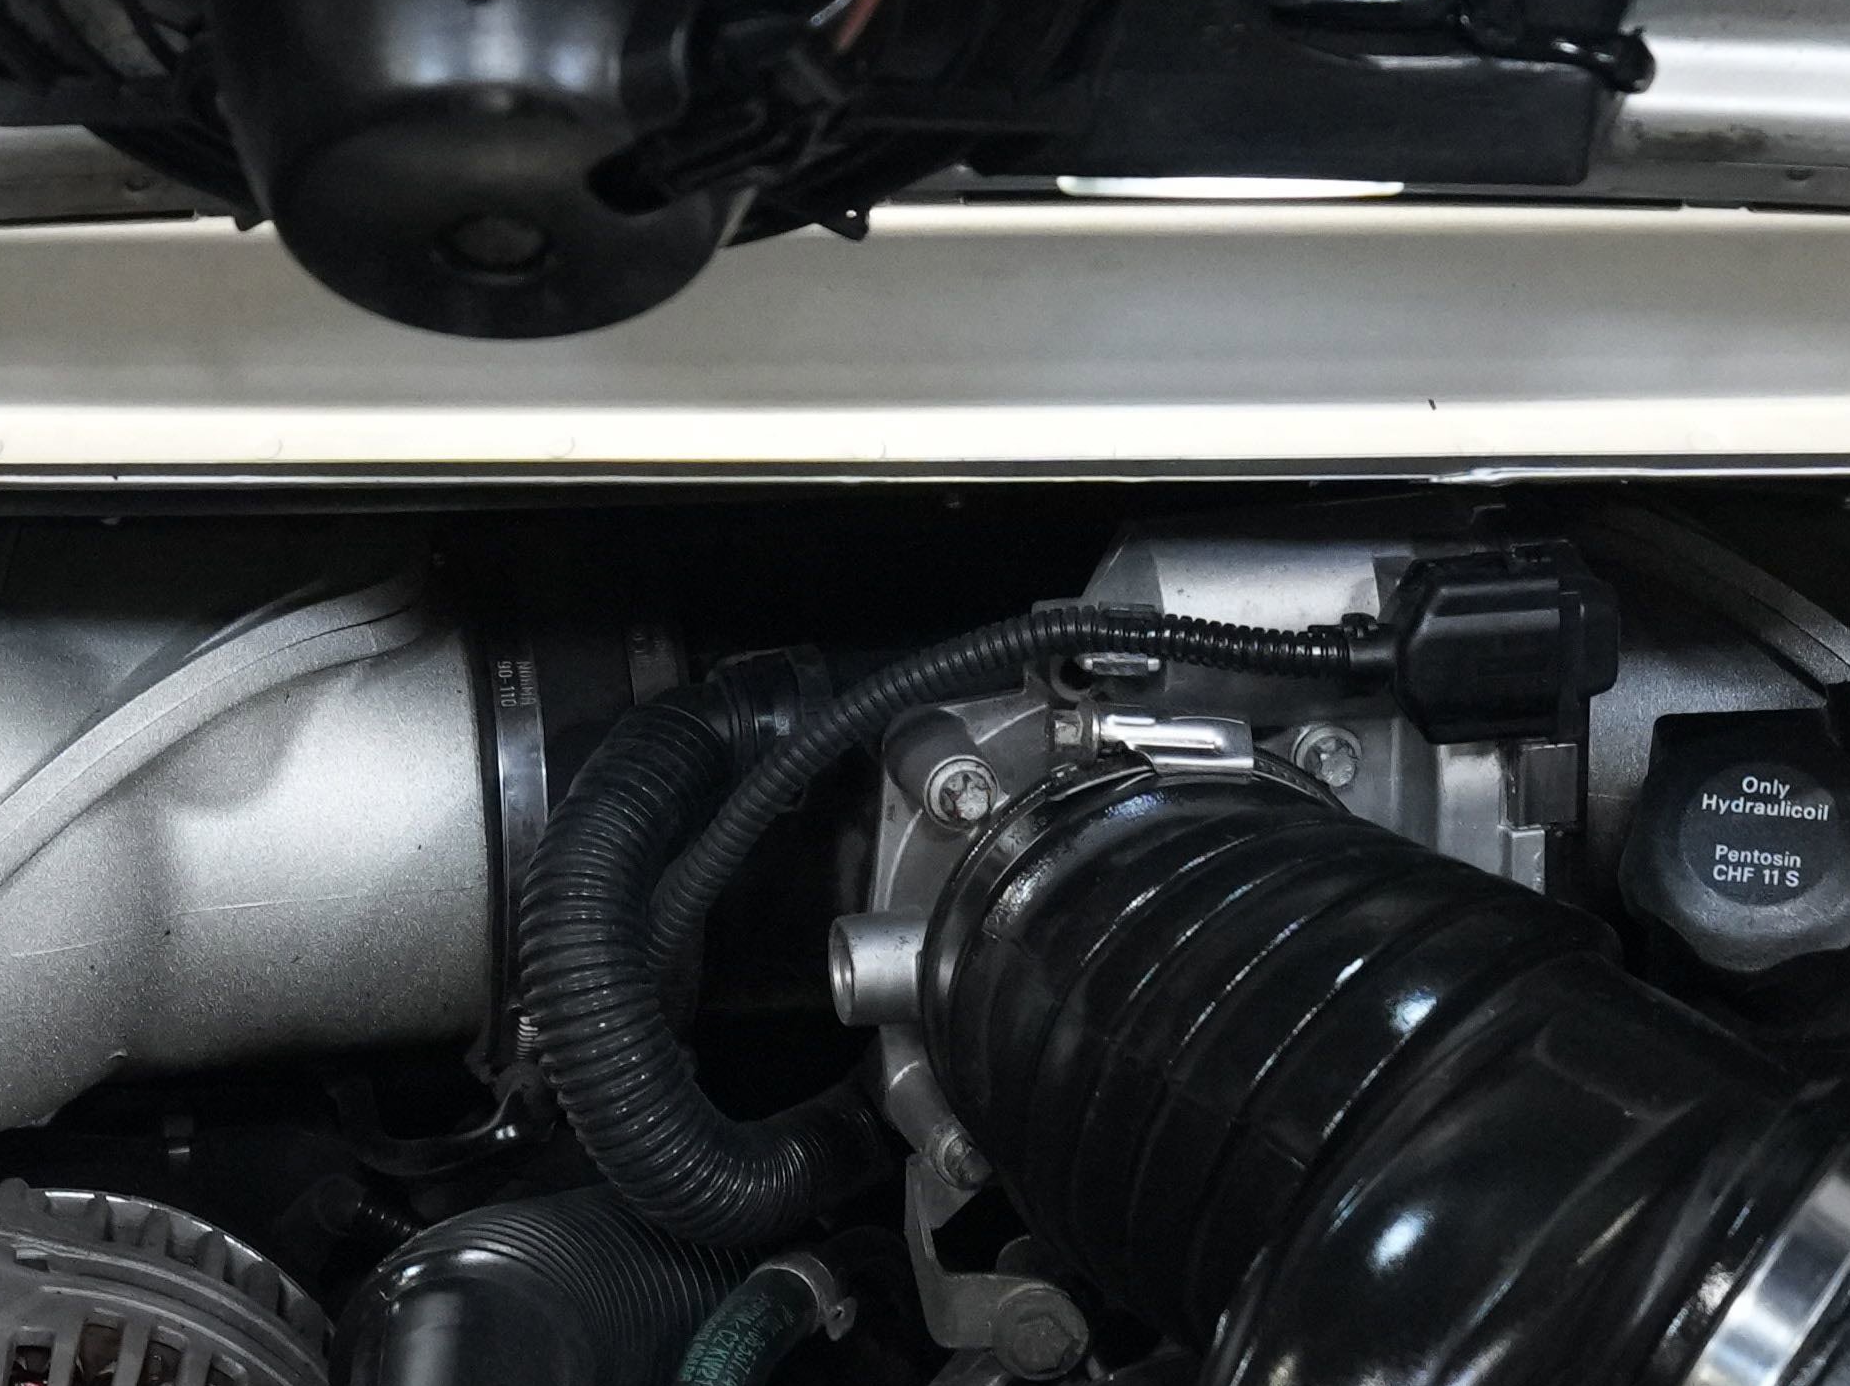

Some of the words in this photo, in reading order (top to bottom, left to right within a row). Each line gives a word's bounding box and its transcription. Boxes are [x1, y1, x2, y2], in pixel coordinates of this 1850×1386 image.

[497, 661, 517, 707] 90-110
[1741, 776, 1791, 800] Only
[1701, 793, 1830, 821] Hydraulicoil
[1714, 844, 1802, 869] Pentosin
[1712, 864, 1756, 884] CHF
[1762, 868, 1780, 886] 11
[1784, 869, 1801, 888] S
